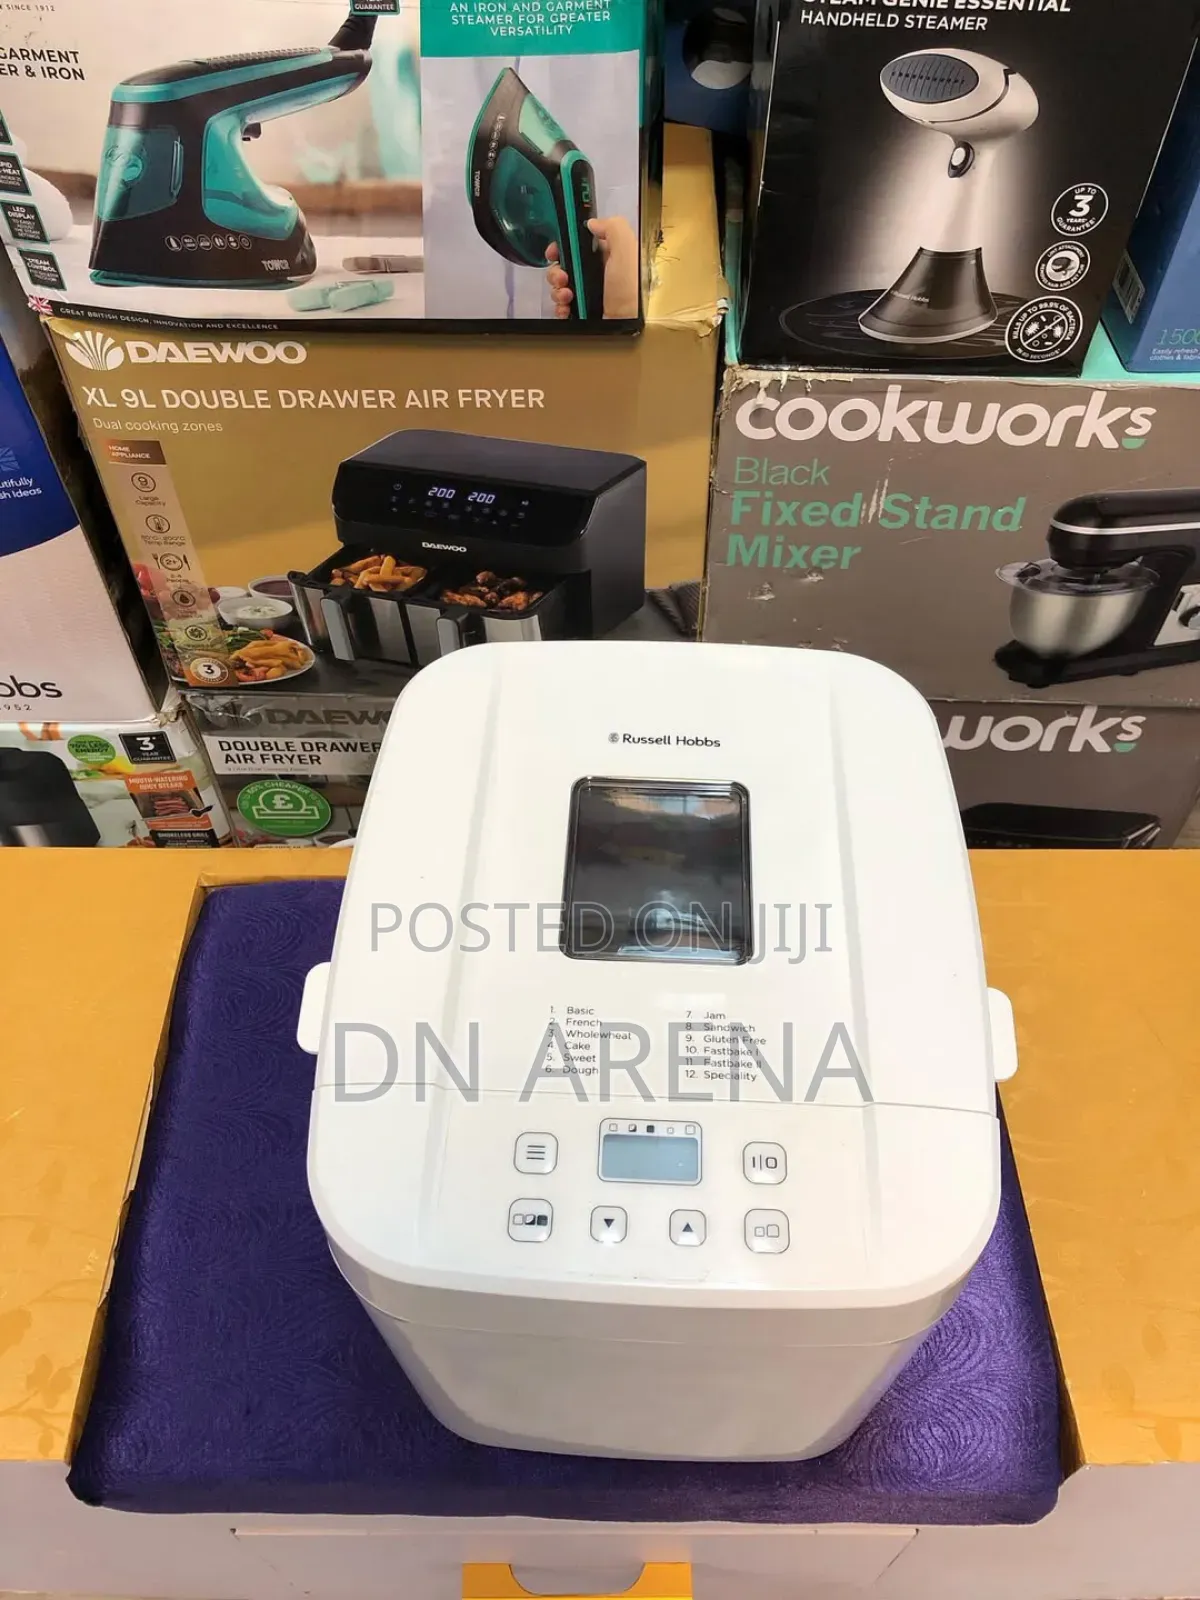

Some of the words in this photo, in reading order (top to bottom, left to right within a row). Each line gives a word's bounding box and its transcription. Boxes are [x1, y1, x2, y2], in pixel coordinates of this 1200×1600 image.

[354, 3, 395, 11] GUARANTEE
[450, 3, 469, 13] AN
[473, 2, 507, 13] IRON
[512, 2, 541, 12] AND
[546, 0, 612, 12] GARMENT
[451, 14, 513, 26] STEAMER
[518, 13, 544, 24] FOR
[550, 11, 611, 23] GREATER
[801, 9, 900, 28] HANDHELD
[904, 14, 988, 31] STEAMER
[490, 25, 573, 37] VERSATILITY
[24, 64, 37, 78] &
[40, 66, 85, 81] IRON
[1087, 187, 1097, 195] TO
[1068, 194, 1094, 218] 3
[1027, 305, 1038, 314] TO
[1059, 304, 1070, 312] OF
[59, 307, 85, 317] GREAT
[87, 310, 118, 321] BRITISH
[120, 314, 152, 325] DESIGN,
[152, 318, 203, 329] INNOVATION
[226, 323, 279, 331] EXCELLENCE
[125, 340, 308, 365] DAEWOO
[81, 386, 117, 409] XL
[120, 388, 157, 409] 9L
[161, 389, 272, 410] DOUBLE
[277, 389, 397, 409] DRAWER
[404, 389, 450, 409] AIR
[457, 388, 545, 409] FRYER
[734, 384, 1157, 449] cookworks
[92, 417, 122, 430] Dual
[125, 419, 180, 434] cooking
[182, 421, 223, 433] zones
[111, 451, 151, 459] APPLIANCE
[734, 456, 830, 486] Black
[11, 487, 42, 498] Ideas
[427, 486, 456, 499] 200
[467, 491, 496, 505] 200
[730, 490, 863, 528] Fixed
[880, 493, 1027, 532] Stand
[421, 541, 468, 553] DAEWOO
[727, 533, 861, 570] Mixer
[202, 664, 215, 675] 3
[218, 740, 297, 752] DOUBLE
[301, 741, 382, 753] DRAWER
[622, 733, 671, 745] Russell
[676, 735, 721, 748] Hobbs
[224, 753, 256, 764] AIR
[260, 753, 322, 765] FRYER
[264, 781, 311, 795] CHEAPER
[566, 1006, 595, 1016] Basic
[703, 1012, 726, 1020] Jam
[565, 1017, 603, 1027] French
[703, 1023, 756, 1033] Sandwich
[565, 1030, 632, 1040] Wholewheat
[703, 1035, 739, 1044] Gluten
[742, 1036, 767, 1045] Free
[564, 1041, 591, 1051] Cake
[703, 1046, 753, 1057] Fastbake
[563, 1053, 597, 1063] Sweet
[703, 1058, 753, 1069] Fastbake
[562, 1065, 600, 1077] Dough
[703, 1070, 758, 1083] Speciality
